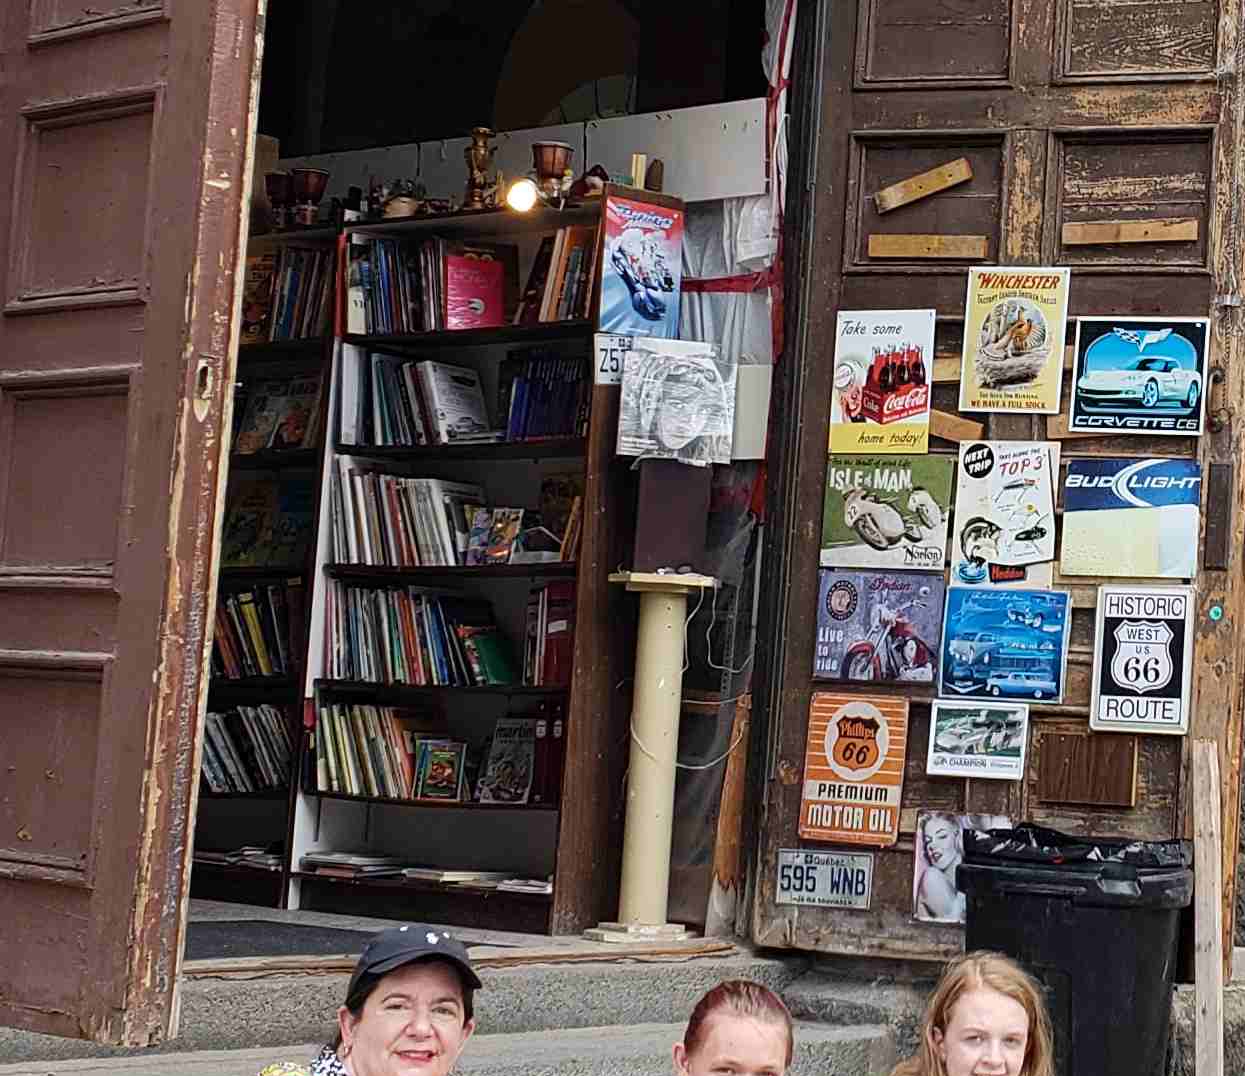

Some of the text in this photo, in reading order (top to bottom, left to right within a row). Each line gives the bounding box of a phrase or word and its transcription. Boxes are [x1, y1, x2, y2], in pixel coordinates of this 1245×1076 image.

[978, 273, 1060, 289] WINCHESTER
[841, 320, 903, 336] Take some
[1074, 415, 1199, 430] CORVETTE C6
[858, 430, 925, 446] home today!
[964, 447, 990, 465] NEXT
[968, 459, 993, 475] TRIP
[999, 457, 1031, 477] TOP
[829, 467, 864, 491] ISLE
[1065, 474, 1201, 489] BUD LIGHT
[903, 544, 943, 562] Norton
[1108, 596, 1183, 616] HISTORIC
[819, 626, 844, 642] Live
[1127, 628, 1161, 641] WEST
[818, 644, 829, 657] to
[816, 659, 838, 672] ride
[1123, 656, 1161, 683] 66
[1106, 698, 1174, 720] ROUTE
[841, 741, 871, 765] 66
[818, 783, 888, 802] PREMIUM
[807, 803, 892, 833] MOTOR OIL
[780, 864, 866, 896] 595 WNB
